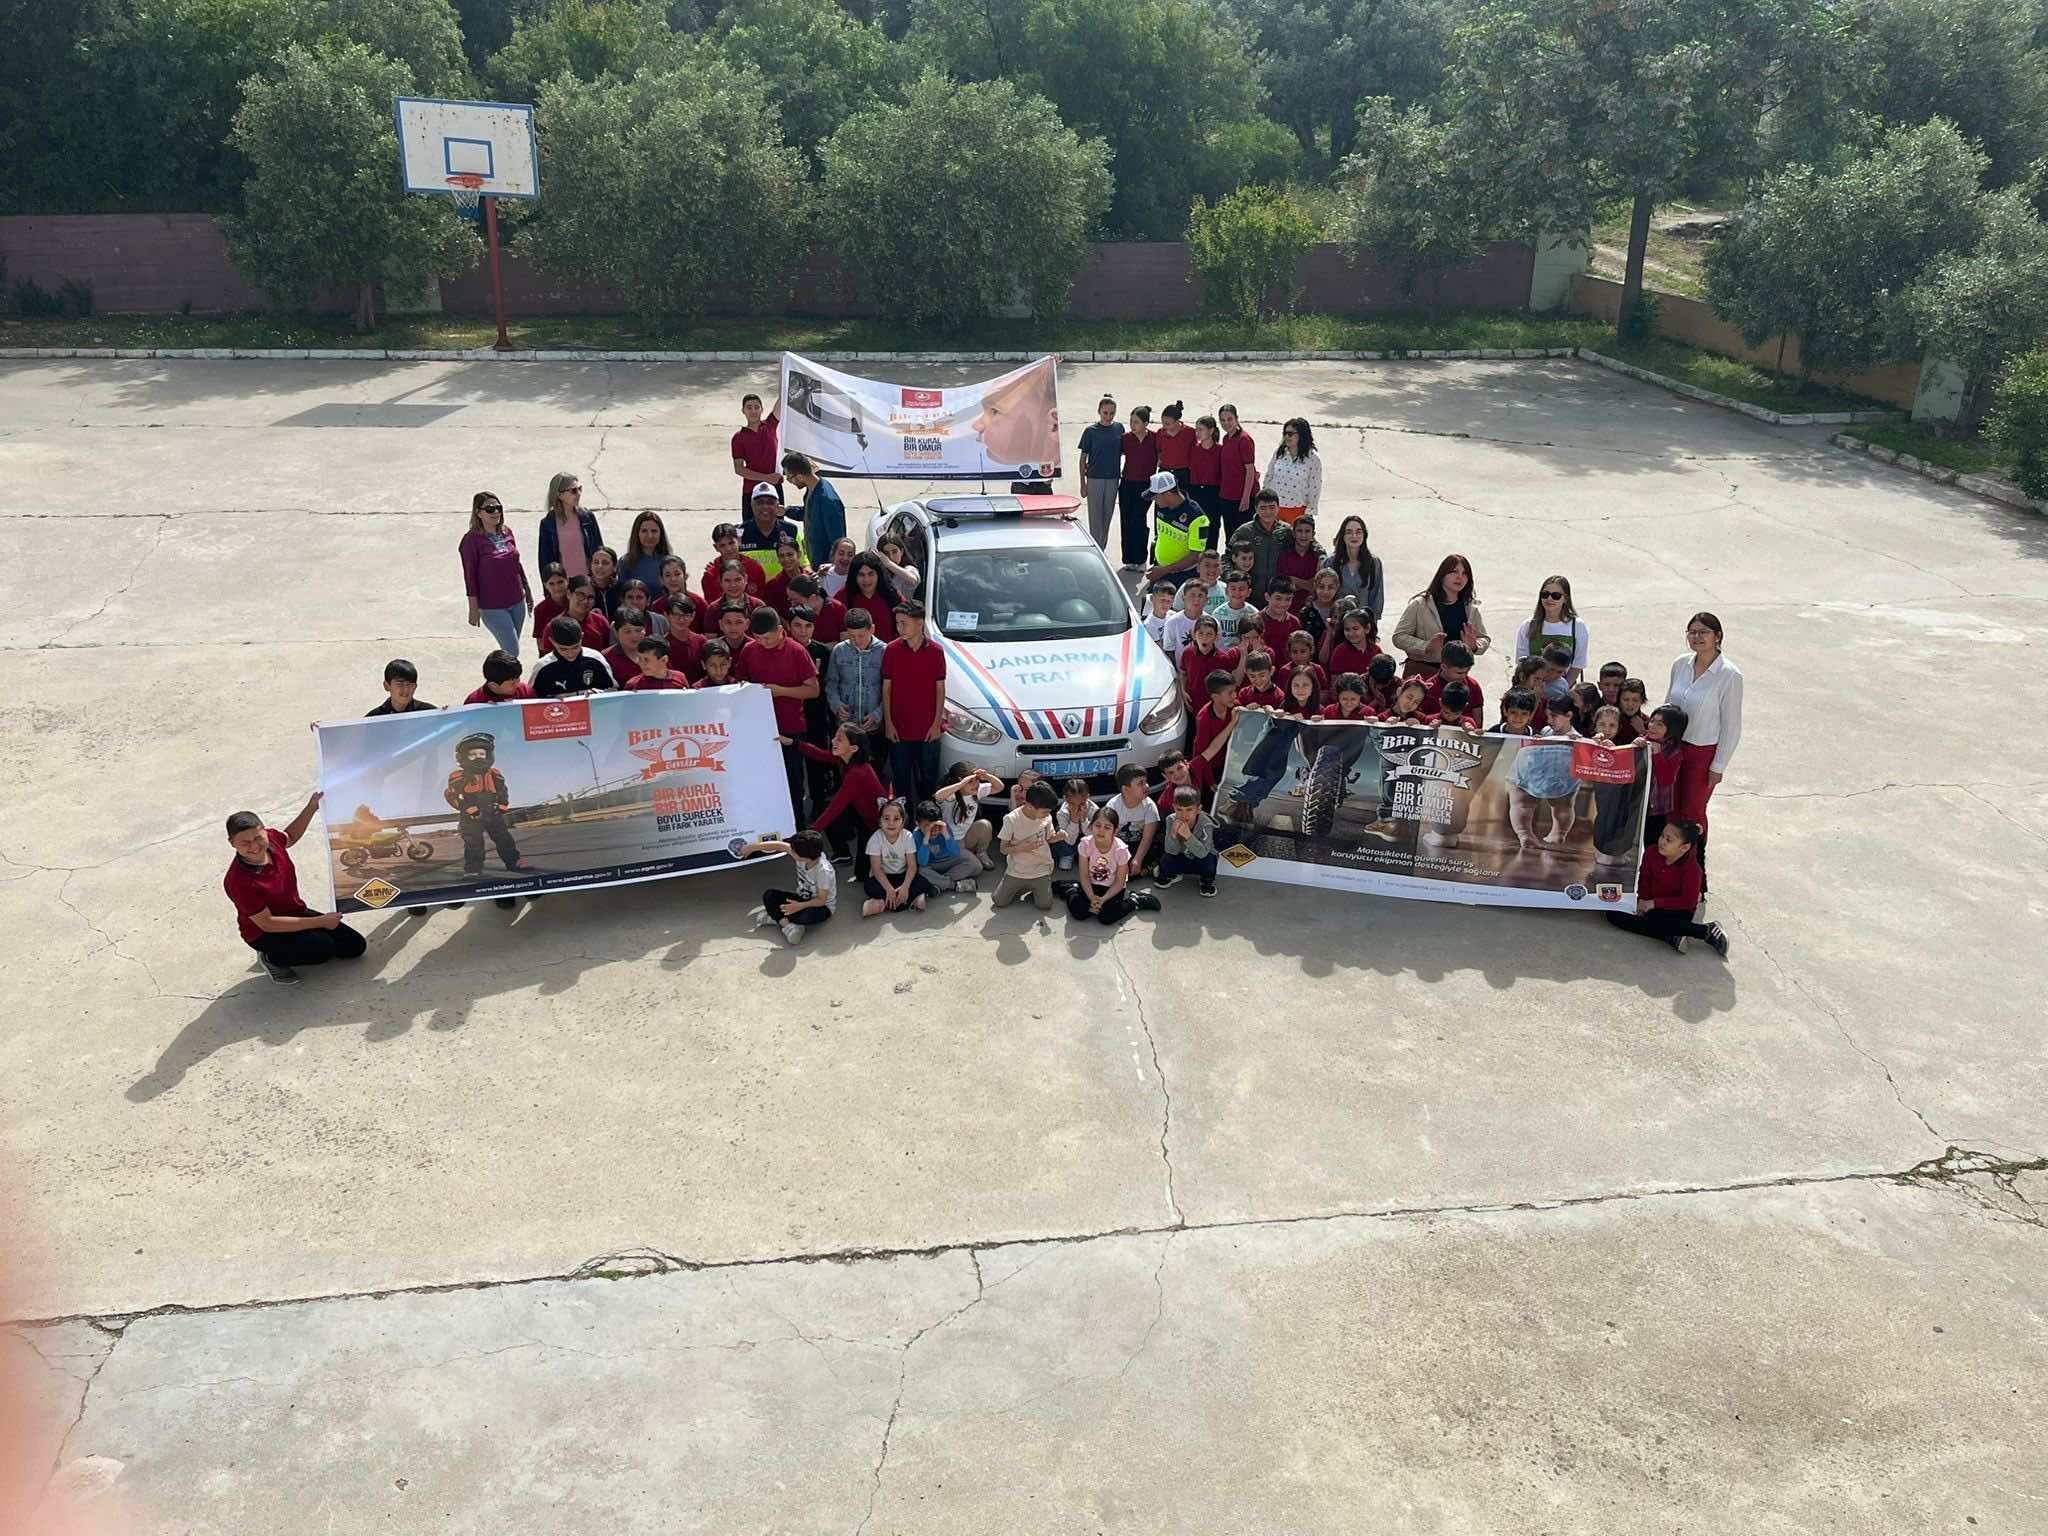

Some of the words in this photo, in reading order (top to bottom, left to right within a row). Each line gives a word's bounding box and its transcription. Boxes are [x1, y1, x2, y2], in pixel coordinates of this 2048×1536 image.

[985, 653, 1119, 670] JANDARMA
[669, 723, 729, 737] KURAL
[672, 742, 685, 757] 1
[1422, 737, 1482, 759] KURAL
[1043, 762, 1056, 774] 09
[1064, 760, 1086, 774] JAA
[1093, 759, 1114, 772] 202
[1420, 751, 1436, 767] 1
[675, 783, 720, 799] KURAL
[1395, 781, 1415, 793] BIR
[1416, 783, 1455, 799] KURAL
[1394, 793, 1414, 805] BIR
[1392, 803, 1414, 813] BOYU
[657, 814, 681, 825] BOYU
[672, 821, 692, 831] FARK
[693, 817, 725, 828] YARATIR
[1331, 850, 1373, 861] koruyucu
